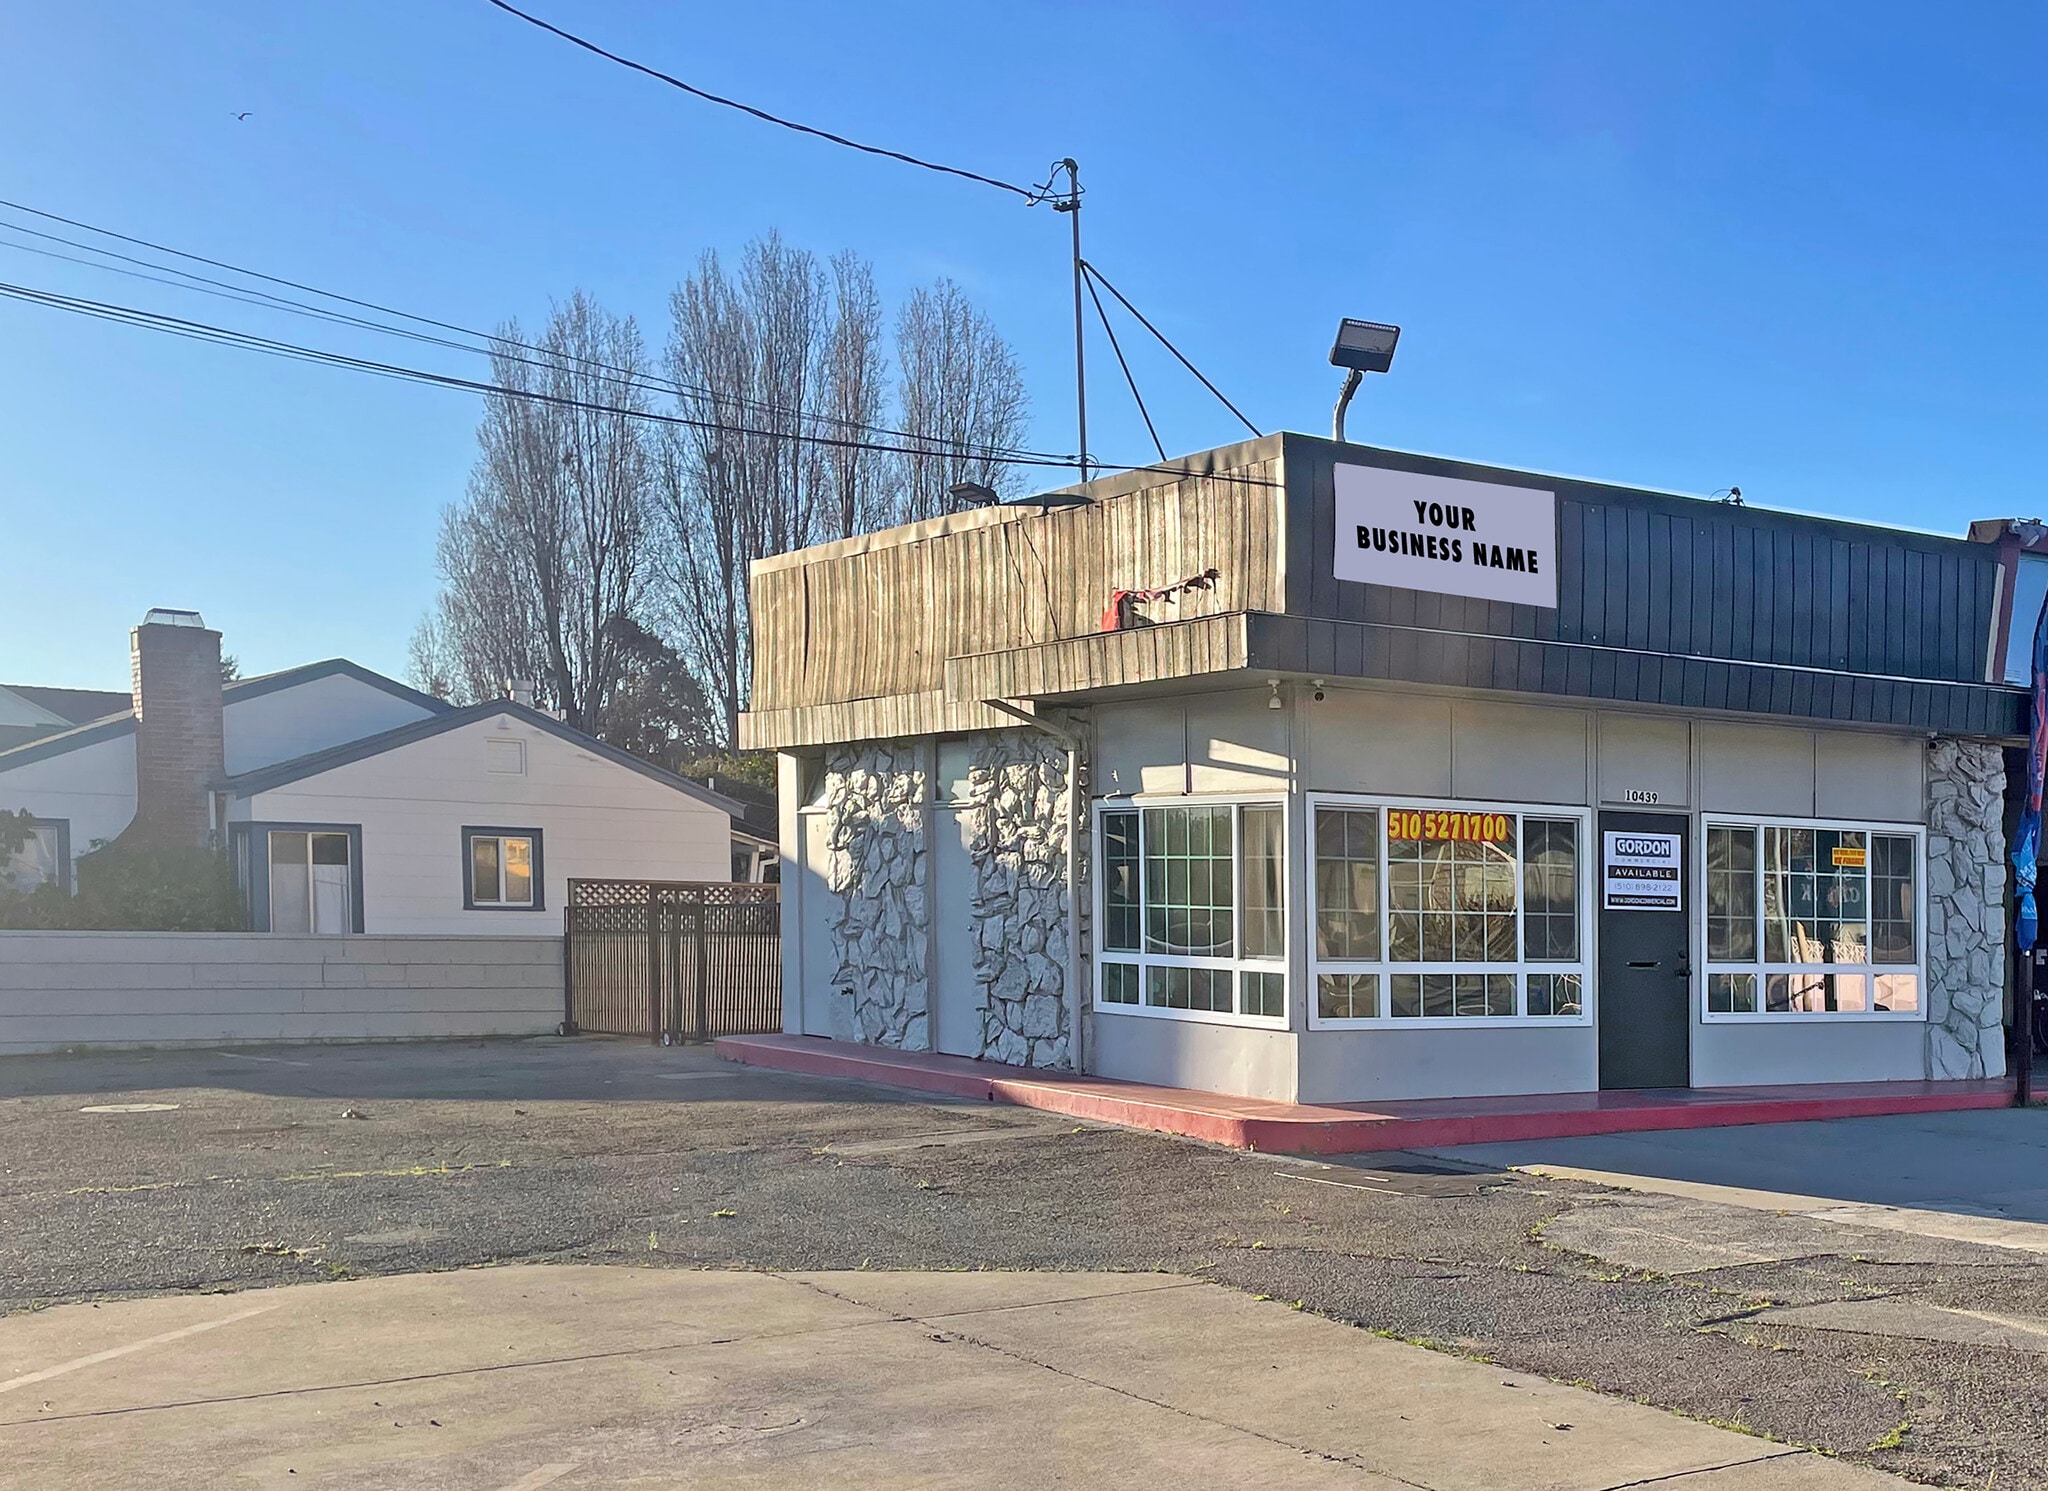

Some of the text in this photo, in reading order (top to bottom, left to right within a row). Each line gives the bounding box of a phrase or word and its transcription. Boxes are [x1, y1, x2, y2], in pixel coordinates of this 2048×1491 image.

[1413, 500, 1476, 531] YOUR
[1356, 525, 1539, 574] BUSINESS NAME
[1625, 790, 1658, 803] 10439
[1388, 812, 1507, 841] 510 5271700
[1616, 839, 1670, 855] GORDON
[1615, 868, 1672, 878] AVAILABLE
[1614, 882, 1634, 890] (510)
